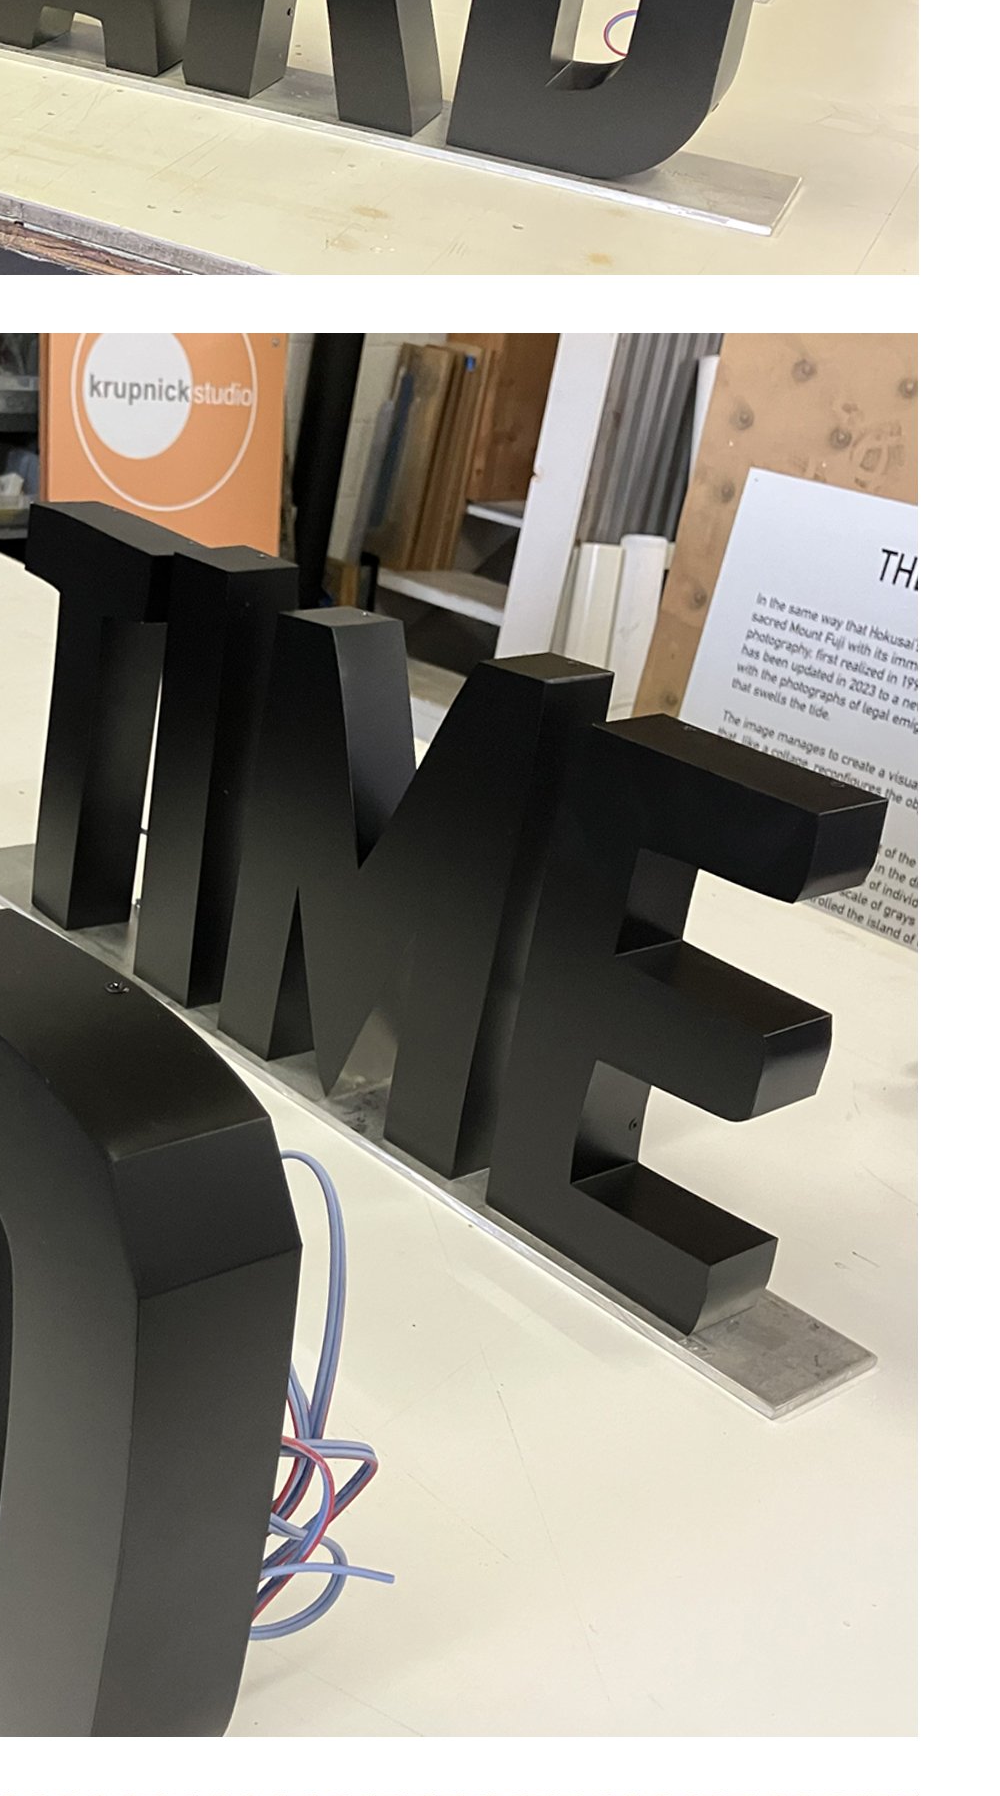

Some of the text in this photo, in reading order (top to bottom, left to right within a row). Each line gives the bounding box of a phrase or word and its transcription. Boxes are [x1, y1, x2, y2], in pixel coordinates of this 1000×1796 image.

[89, 373, 253, 407] krupnick studio
[880, 548, 918, 591] TH
[756, 592, 767, 606] In
[769, 597, 786, 612] the
[788, 605, 819, 622] same
[821, 614, 844, 631] way
[845, 620, 868, 636] that
[752, 612, 788, 631] sacred
[789, 621, 823, 642] Mount
[825, 631, 846, 651] Fuji
[848, 640, 872, 657] with
[874, 646, 889, 662] its
[741, 643, 918, 712] has been updated in 2023 to a ne
[816, 648, 839, 666] first
[840, 659, 886, 681] realized
[886, 669, 898, 684] in
[732, 677, 752, 693] that
[753, 686, 787, 706] swells
[789, 696, 806, 712] the
[737, 662, 759, 677] with
[761, 669, 777, 684] the
[778, 676, 846, 707] photographs
[849, 699, 862, 711] of
[862, 701, 890, 721] legal
[723, 709, 741, 726] The
[743, 716, 775, 739] image
[777, 731, 826, 757] manages
[828, 748, 839, 762] to
[841, 755, 876, 775] create
[878, 768, 886, 779] a
[884, 847, 917, 868] of the
[888, 867, 906, 883] the
[869, 880, 882, 892] of
[24, 500, 888, 1337] TIME
[846, 907, 864, 923] the
[867, 915, 902, 939] island
[903, 933, 916, 945] of
[870, 900, 883, 911] of
[883, 906, 916, 926] grays
